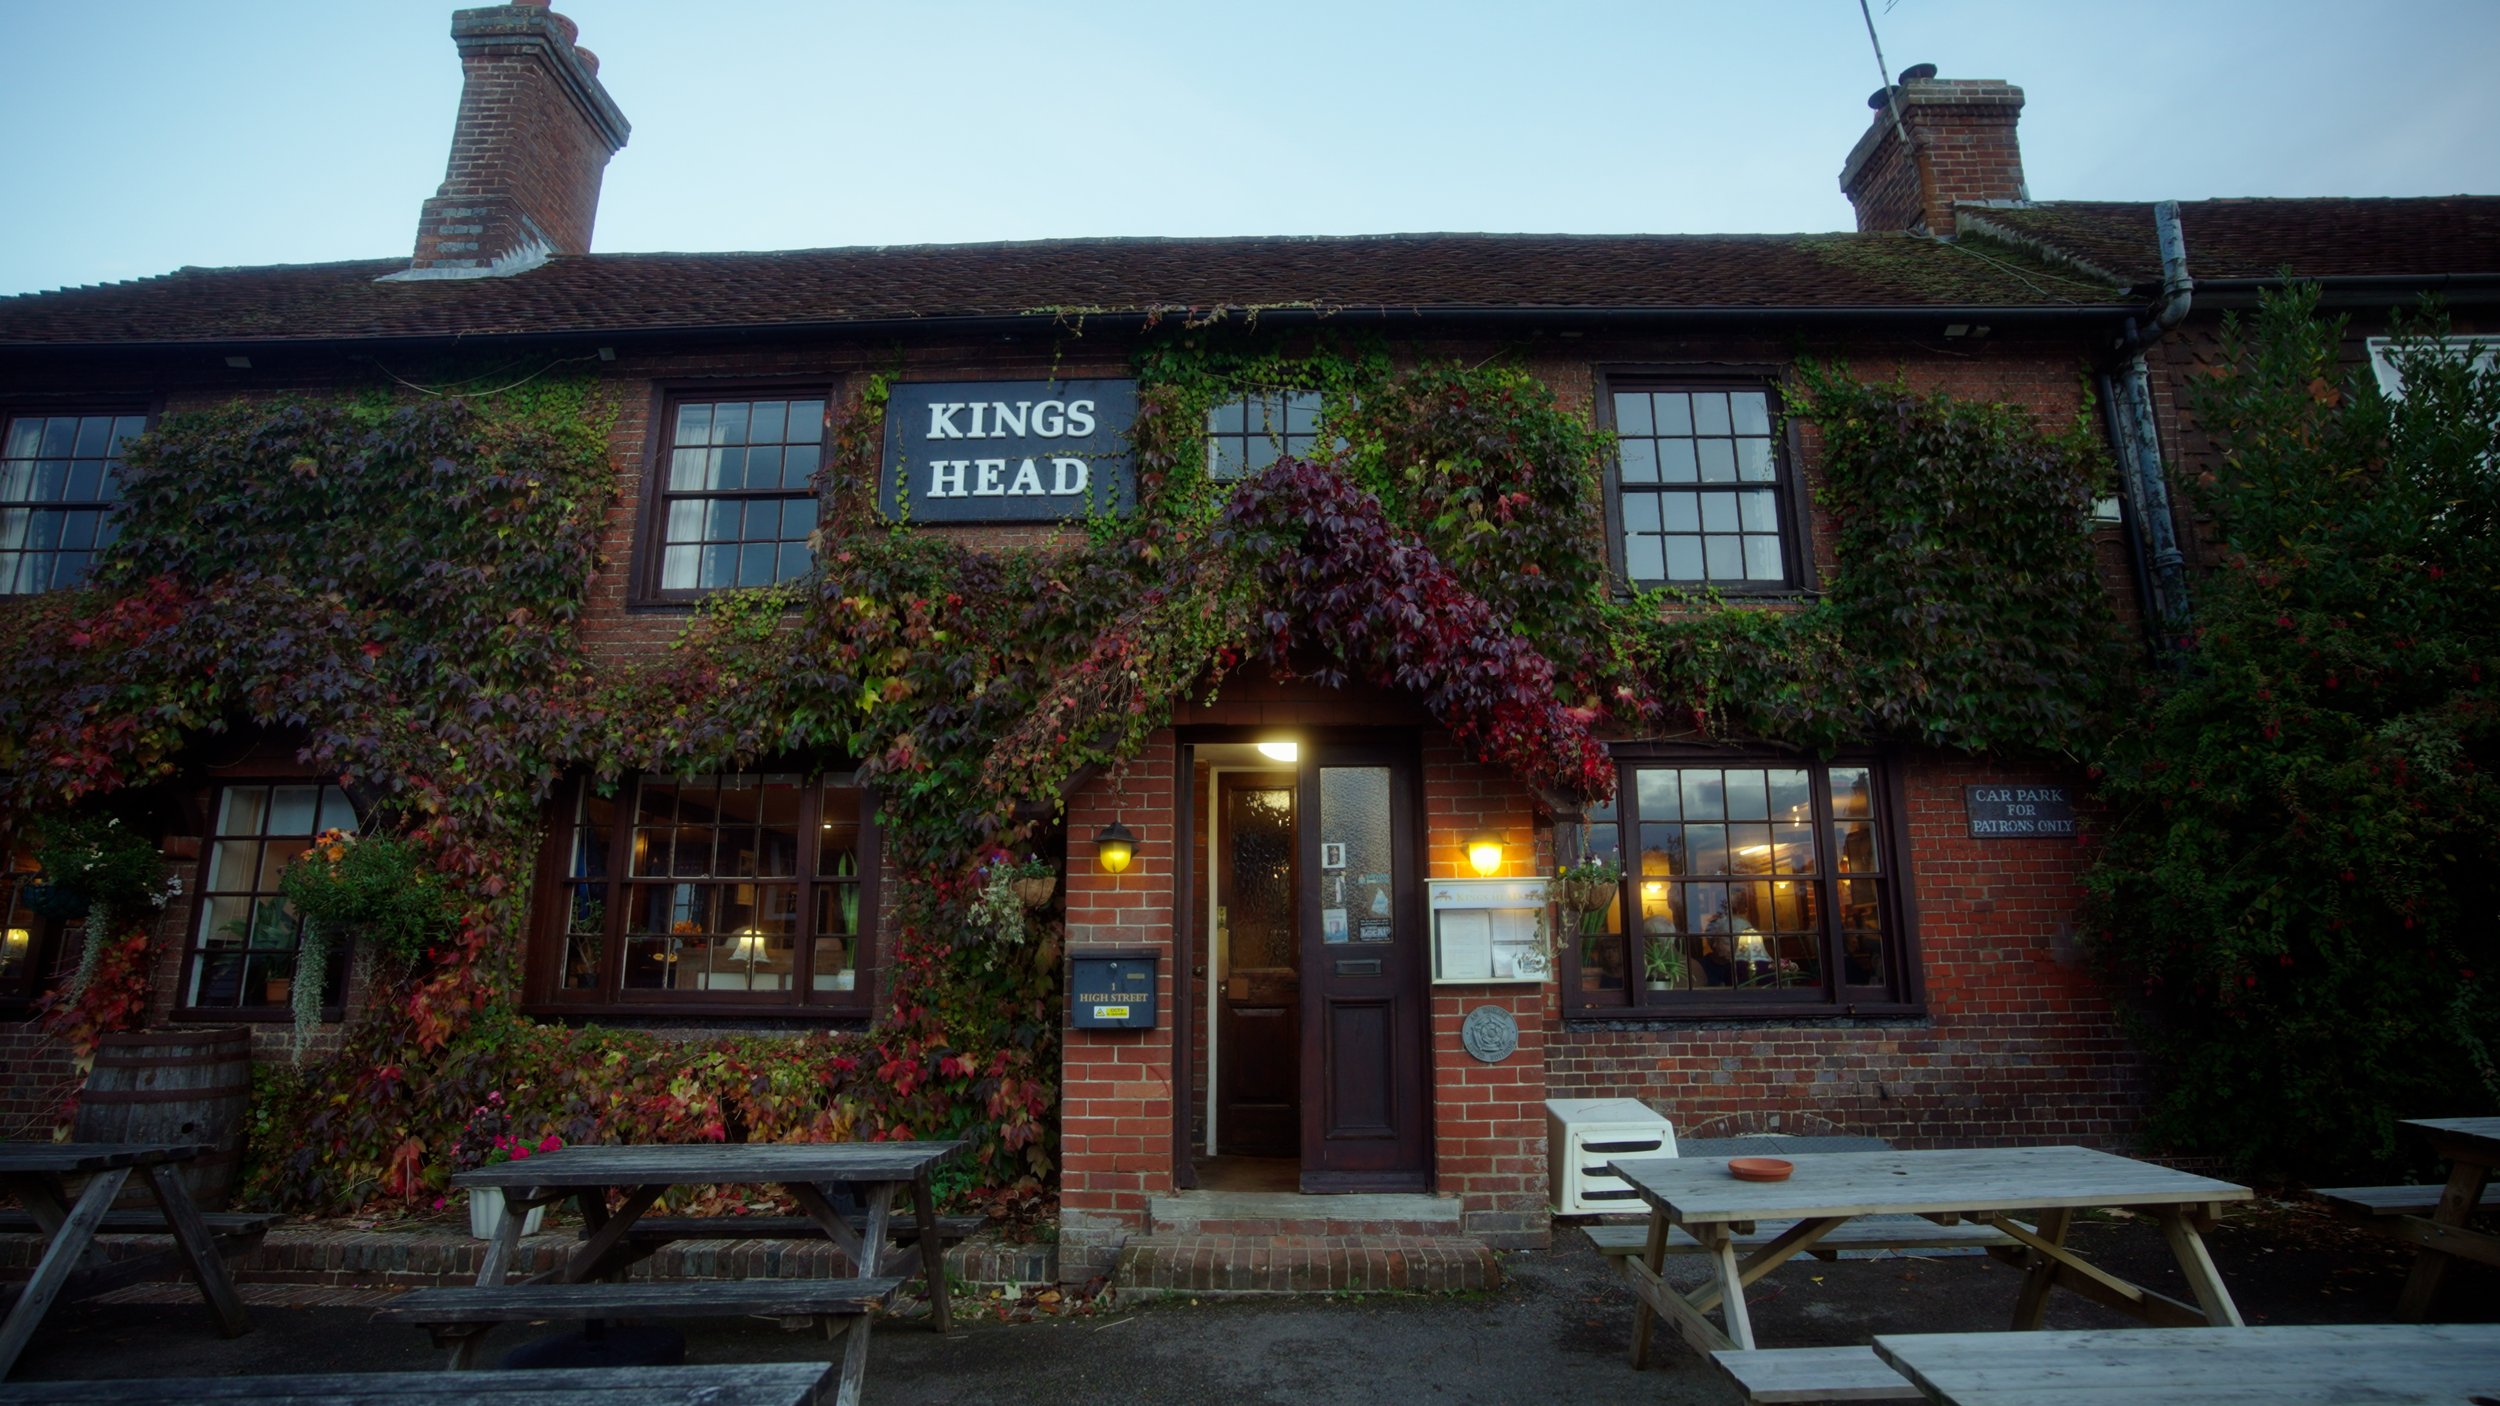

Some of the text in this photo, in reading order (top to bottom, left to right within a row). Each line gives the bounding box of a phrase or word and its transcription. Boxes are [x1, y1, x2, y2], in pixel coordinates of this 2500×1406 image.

[926, 400, 1096, 440] KINGS
[926, 458, 1090, 498] HEAD
[1975, 789, 2064, 802] CAR PARK
[2006, 804, 2036, 816] FOR
[1973, 820, 2073, 832] PATRONS ONLY
[1111, 982, 1116, 991] 1
[1080, 993, 1148, 1002] HIGH STREET
